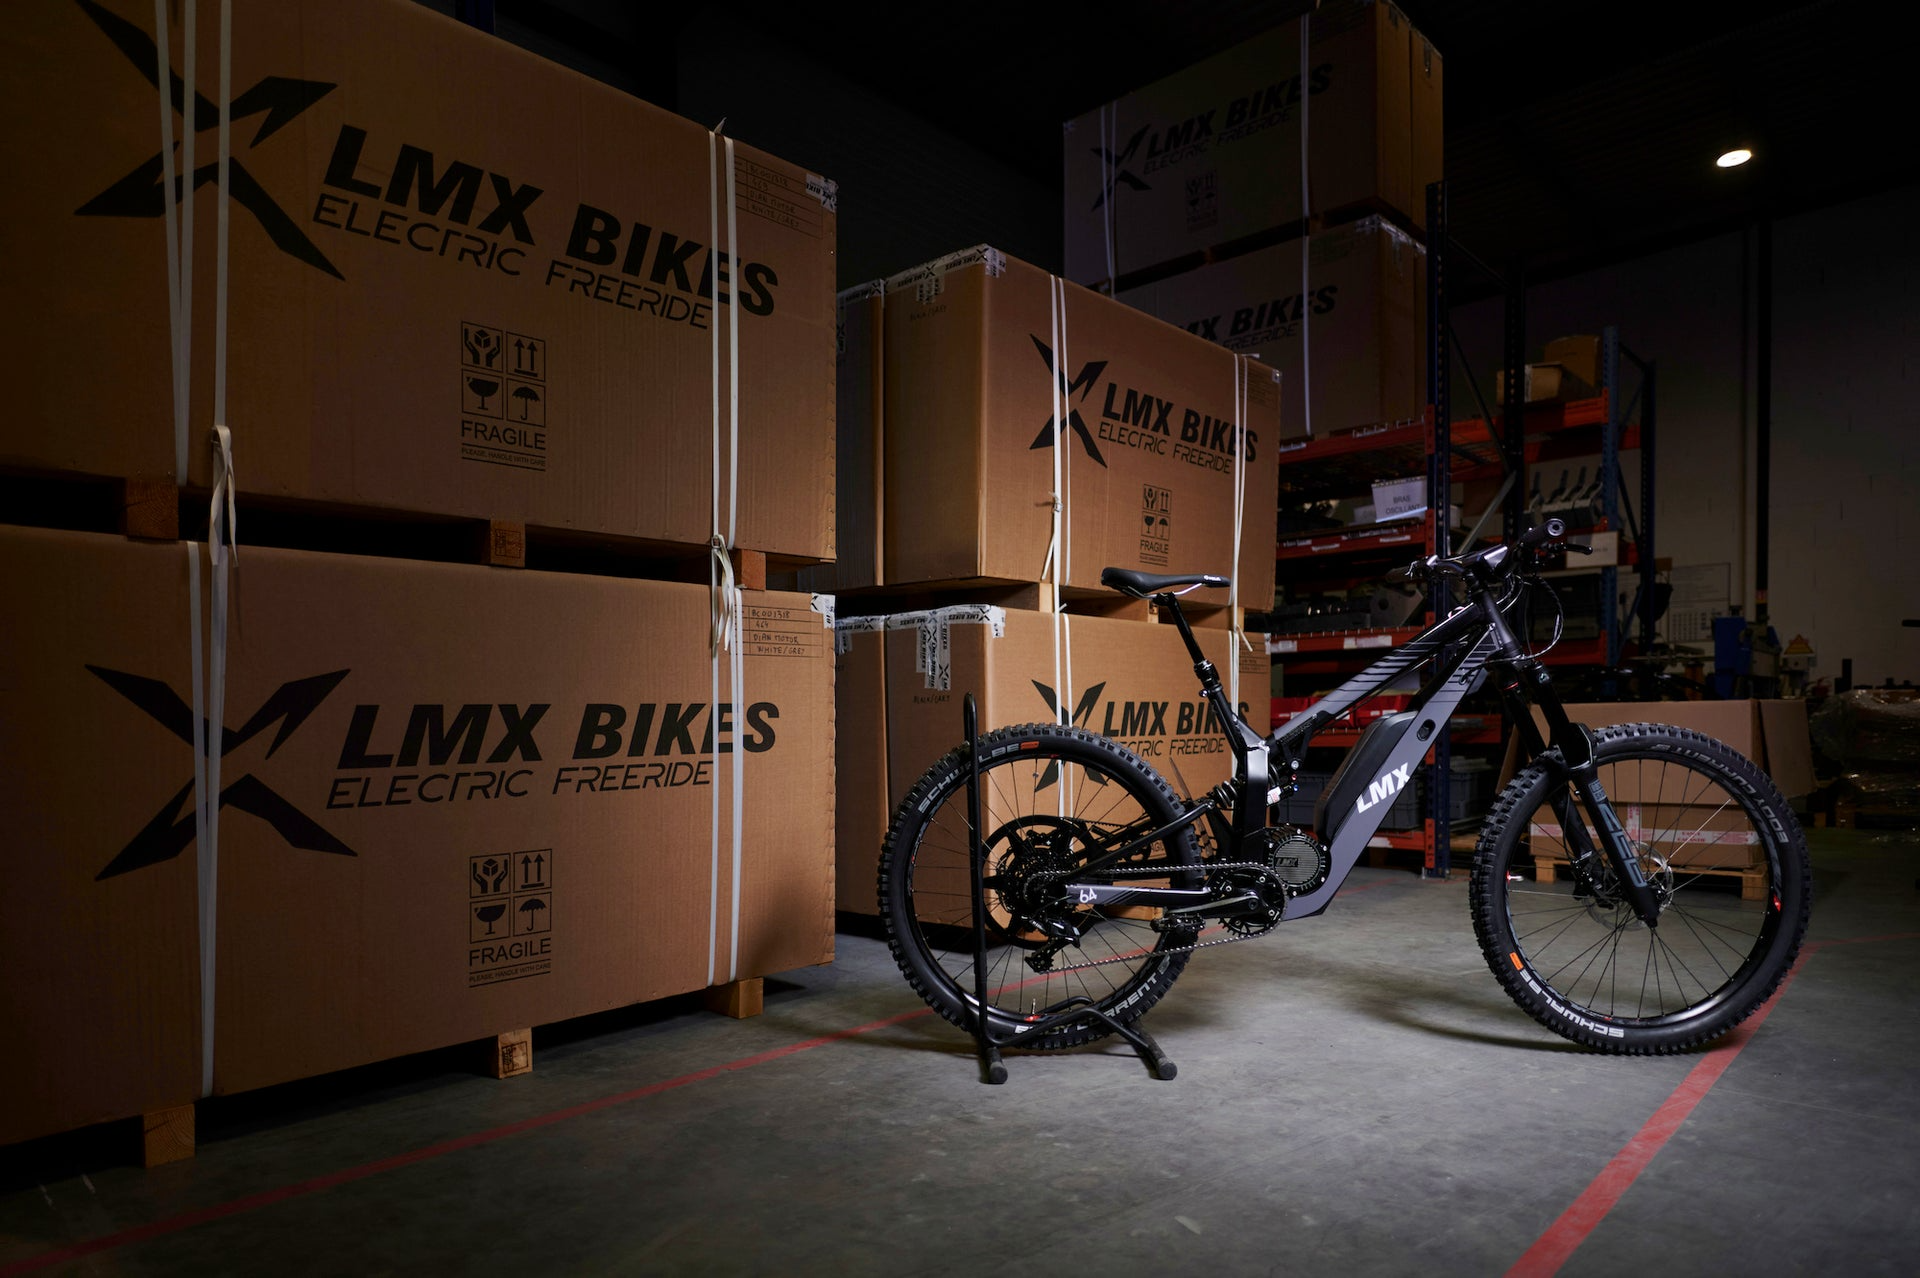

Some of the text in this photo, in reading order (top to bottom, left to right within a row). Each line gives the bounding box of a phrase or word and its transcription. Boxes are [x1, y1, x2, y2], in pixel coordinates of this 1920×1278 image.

[1148, 109, 1216, 158] LMX
[323, 124, 779, 317] LMX BIKES
[313, 193, 712, 330] ELECTRIC FREERIDE
[462, 420, 546, 450] FRAGILE
[1102, 383, 1174, 436] LMX
[1098, 421, 1232, 474] ELECTRIC FREERIDE
[336, 701, 779, 769] LMX BIKES
[1103, 701, 1169, 737] LMX
[1170, 738, 1226, 755] FREERIDE
[326, 760, 714, 810] ELECTRIC FREERIDE
[1356, 762, 1410, 814] LMX
[1753, 798, 1790, 844] EDDY
[469, 938, 552, 966] FRAGILE
[1520, 968, 1624, 1038] SCHWALBE
